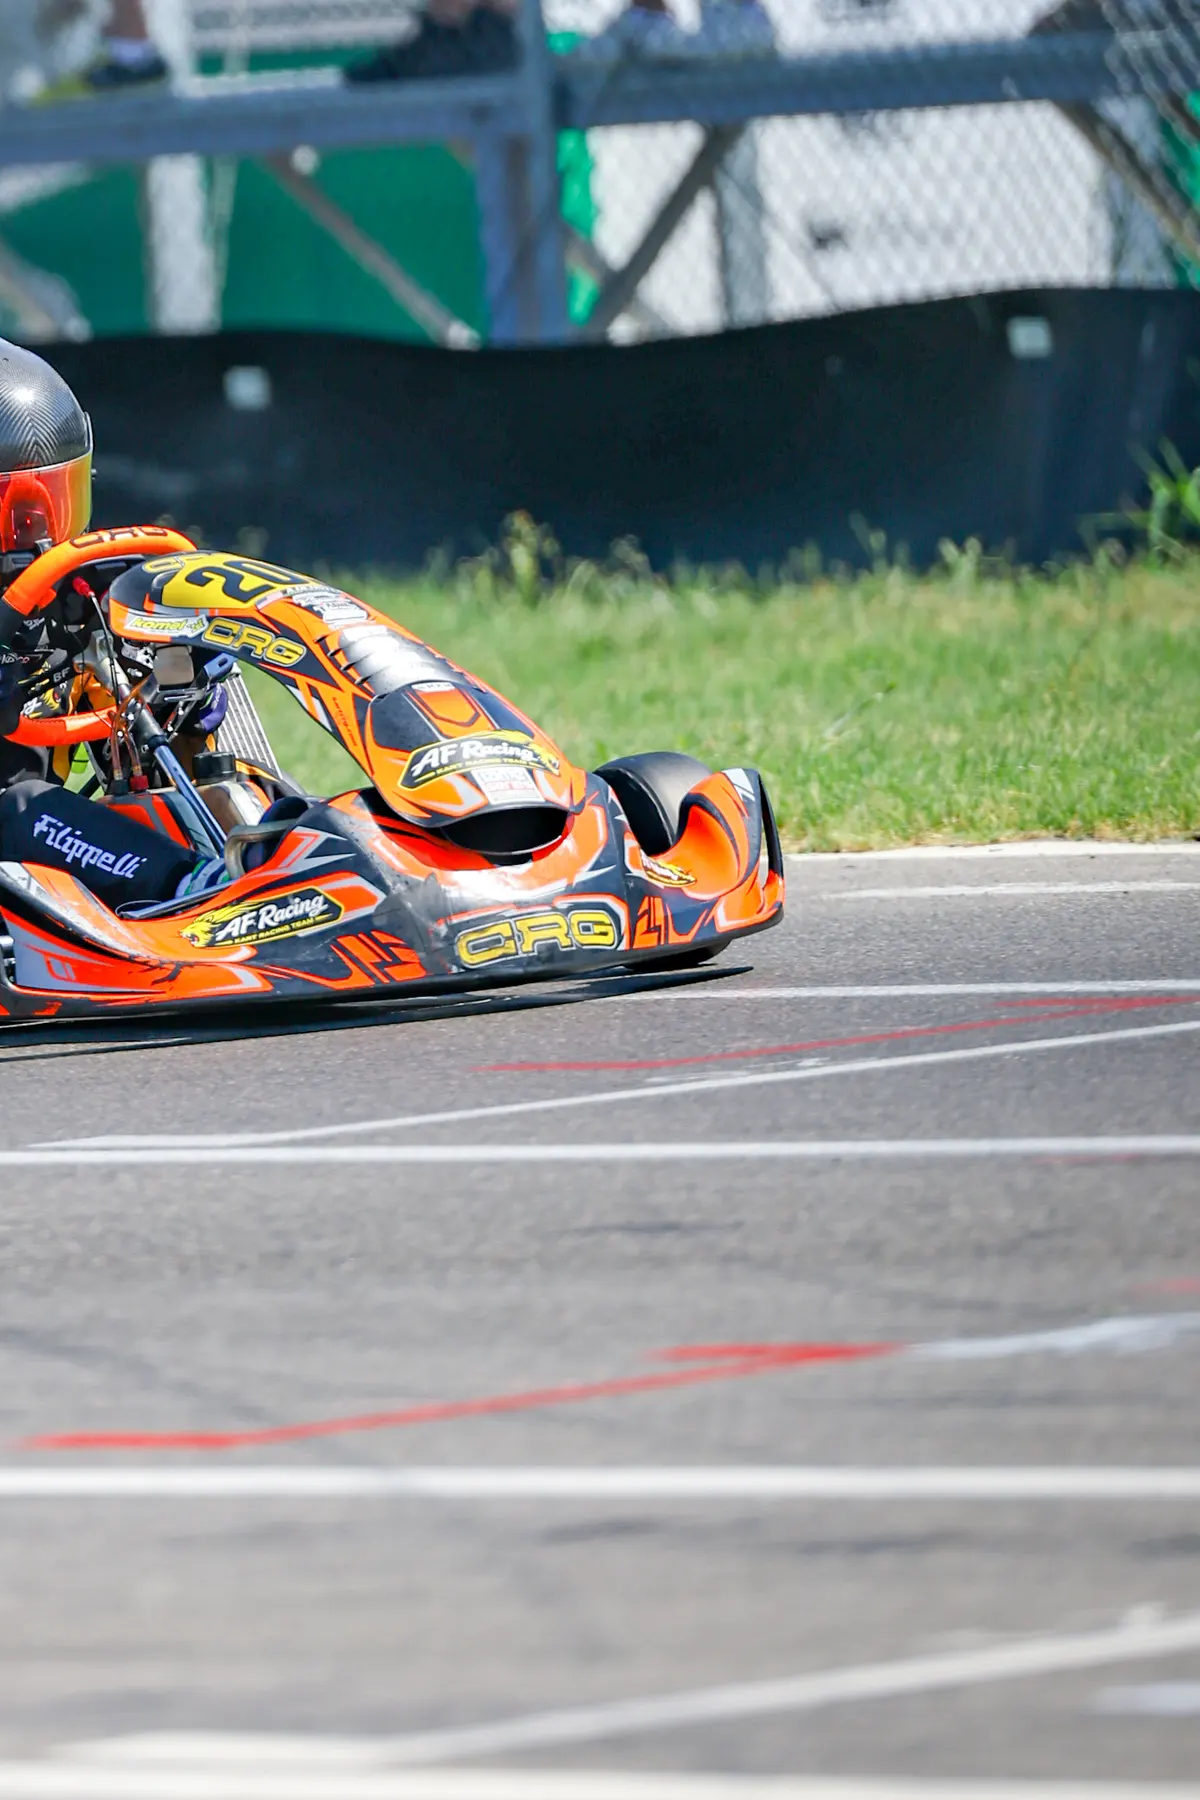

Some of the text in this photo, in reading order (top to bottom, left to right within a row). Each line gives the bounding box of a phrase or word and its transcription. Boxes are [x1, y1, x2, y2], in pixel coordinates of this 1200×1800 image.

[69, 526, 168, 549] CRG
[202, 617, 307, 667] CRG
[410, 743, 458, 777] AF
[459, 740, 539, 761] Racing
[33, 813, 147, 879] Filippelli
[215, 894, 328, 941] AF Racing
[258, 925, 290, 939] RACING
[456, 908, 618, 968] CRG
